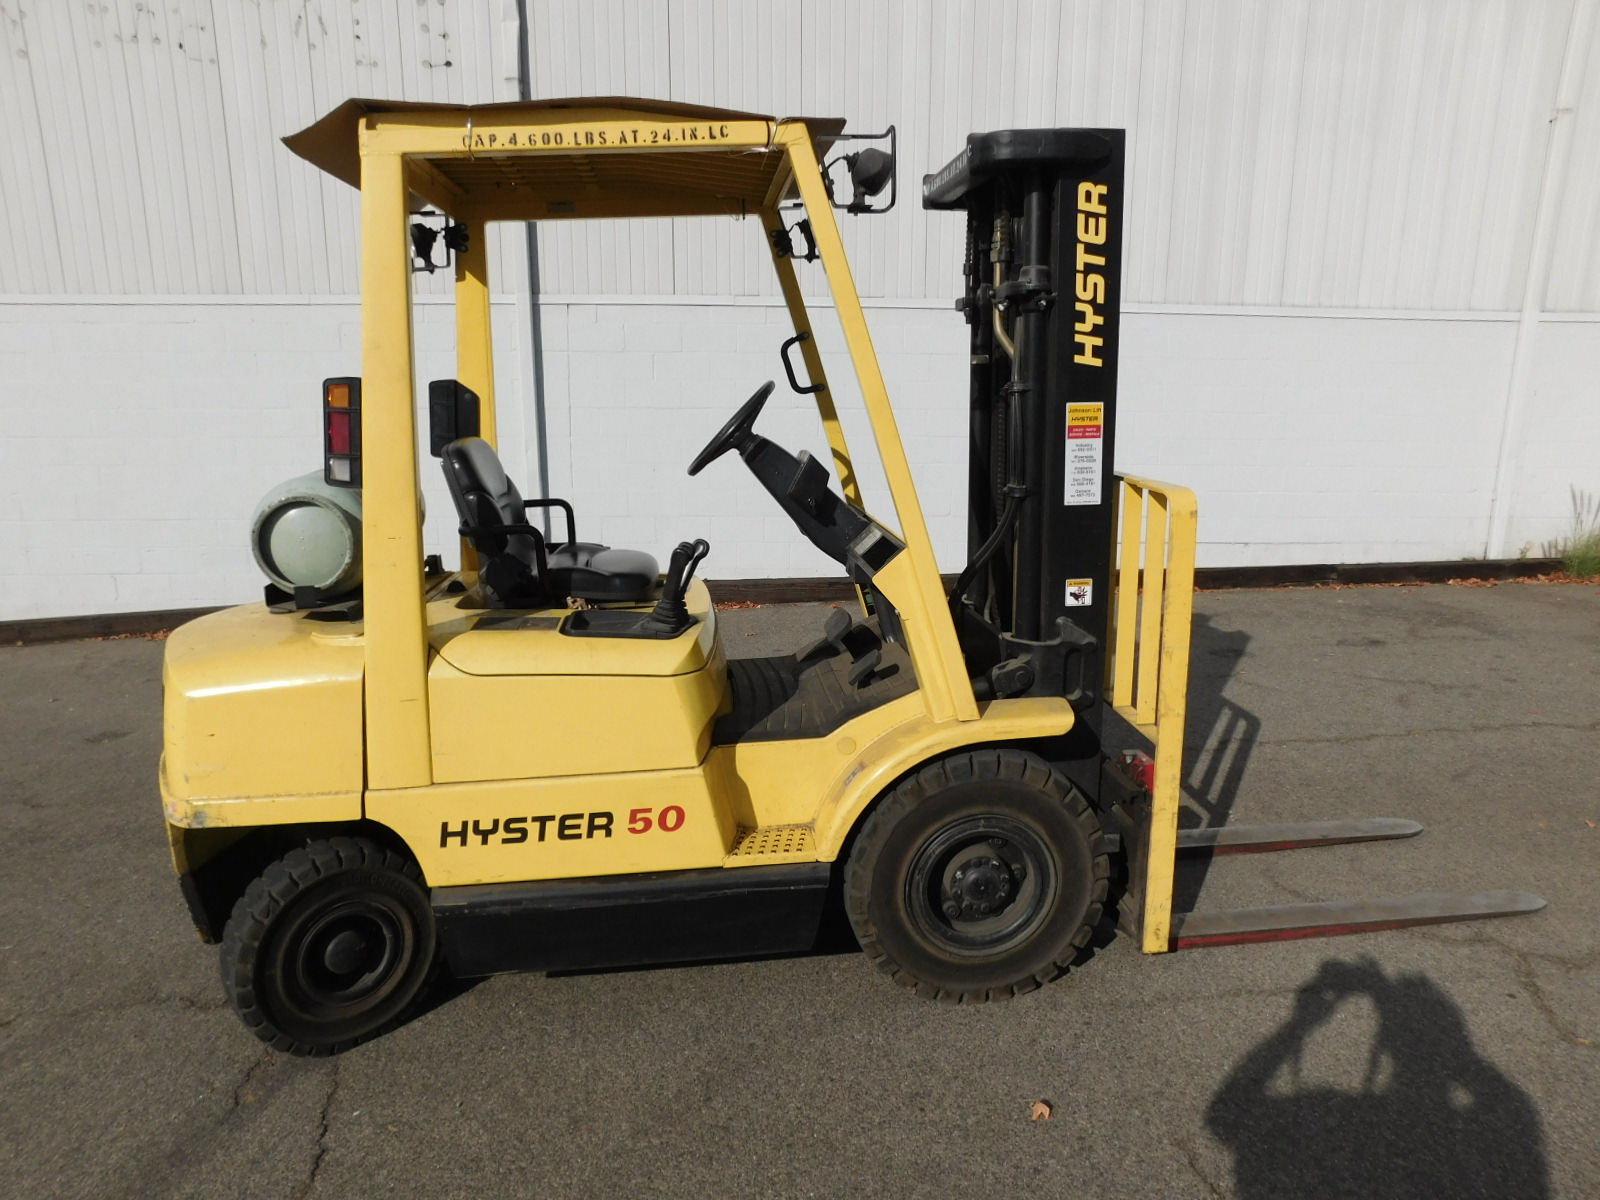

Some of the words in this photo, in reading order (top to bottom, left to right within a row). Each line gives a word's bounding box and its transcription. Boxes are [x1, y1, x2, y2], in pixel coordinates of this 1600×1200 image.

[1073, 181, 1108, 367] HYSTER
[440, 811, 615, 848] HYSTER
[627, 805, 686, 835] 50
